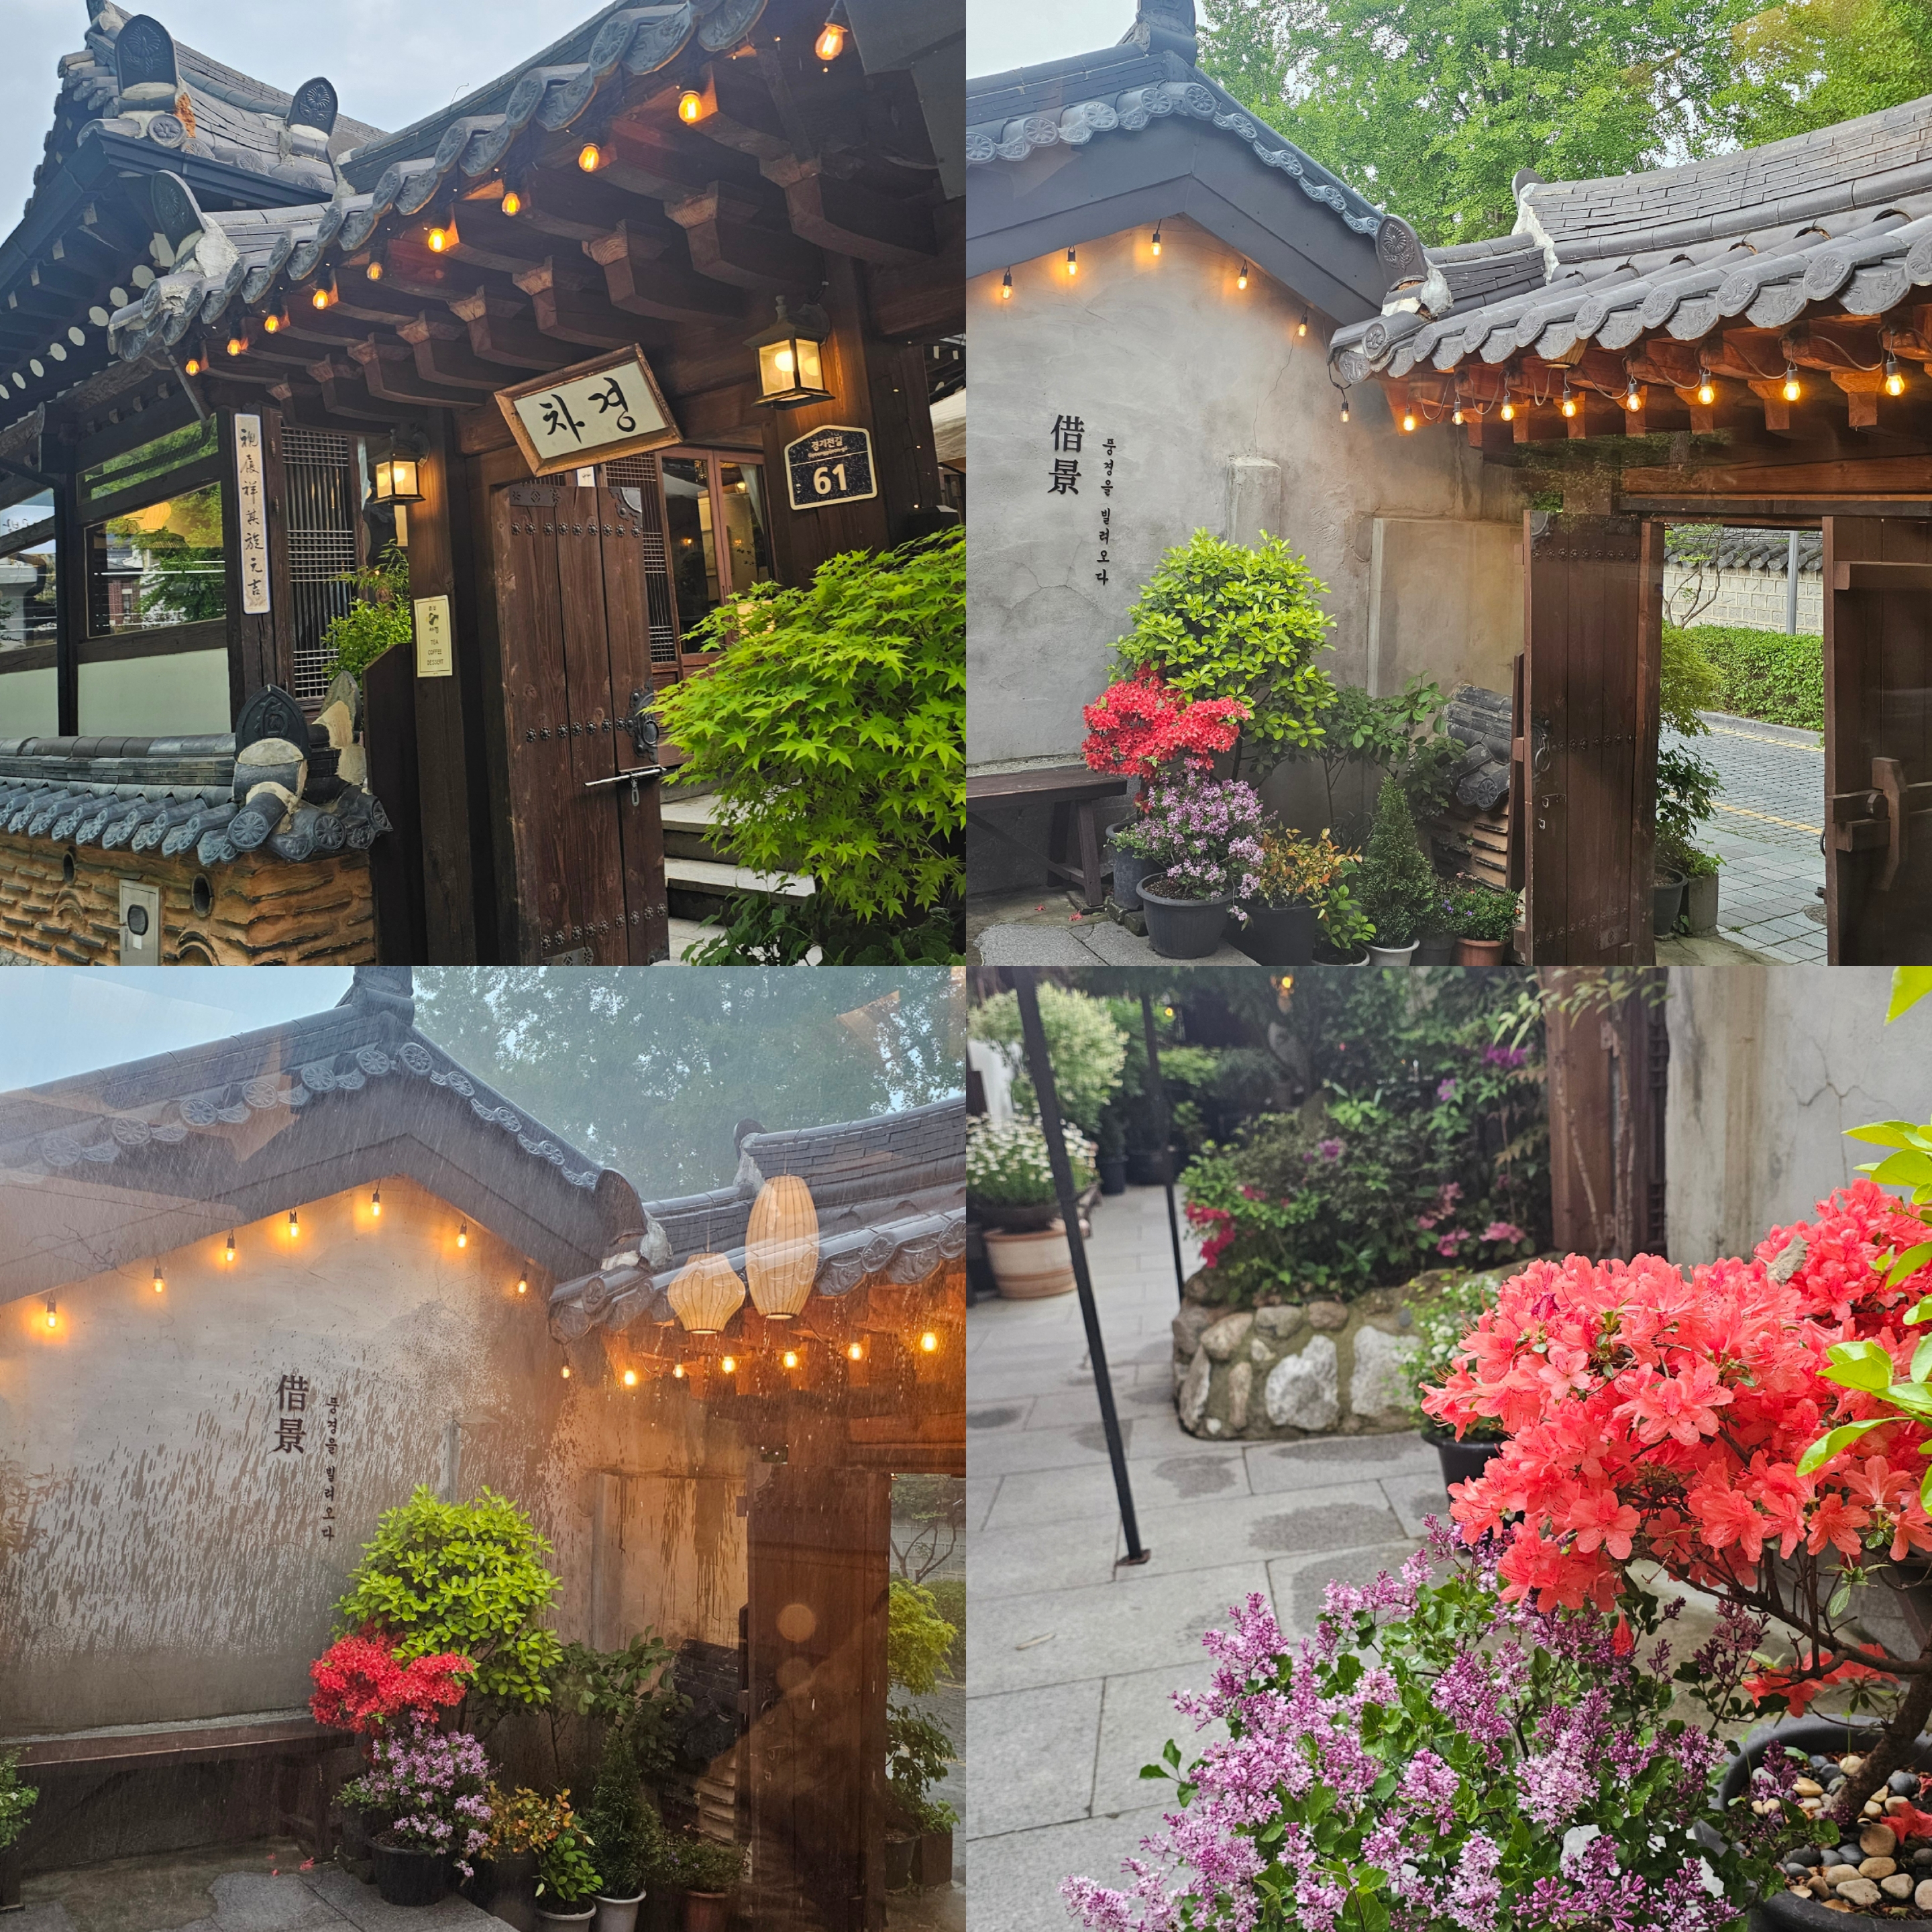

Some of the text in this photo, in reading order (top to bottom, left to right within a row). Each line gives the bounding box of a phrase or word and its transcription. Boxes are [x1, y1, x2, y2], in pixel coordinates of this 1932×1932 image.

[539, 376, 636, 444] 차경
[811, 435, 843, 451] 경기전길
[813, 463, 847, 494] 61
[1047, 414, 1085, 495] 借景
[1095, 438, 1116, 586] 풍경을 빌려오다
[271, 1374, 309, 1454] 借景
[325, 1397, 340, 1454] 풍경을
